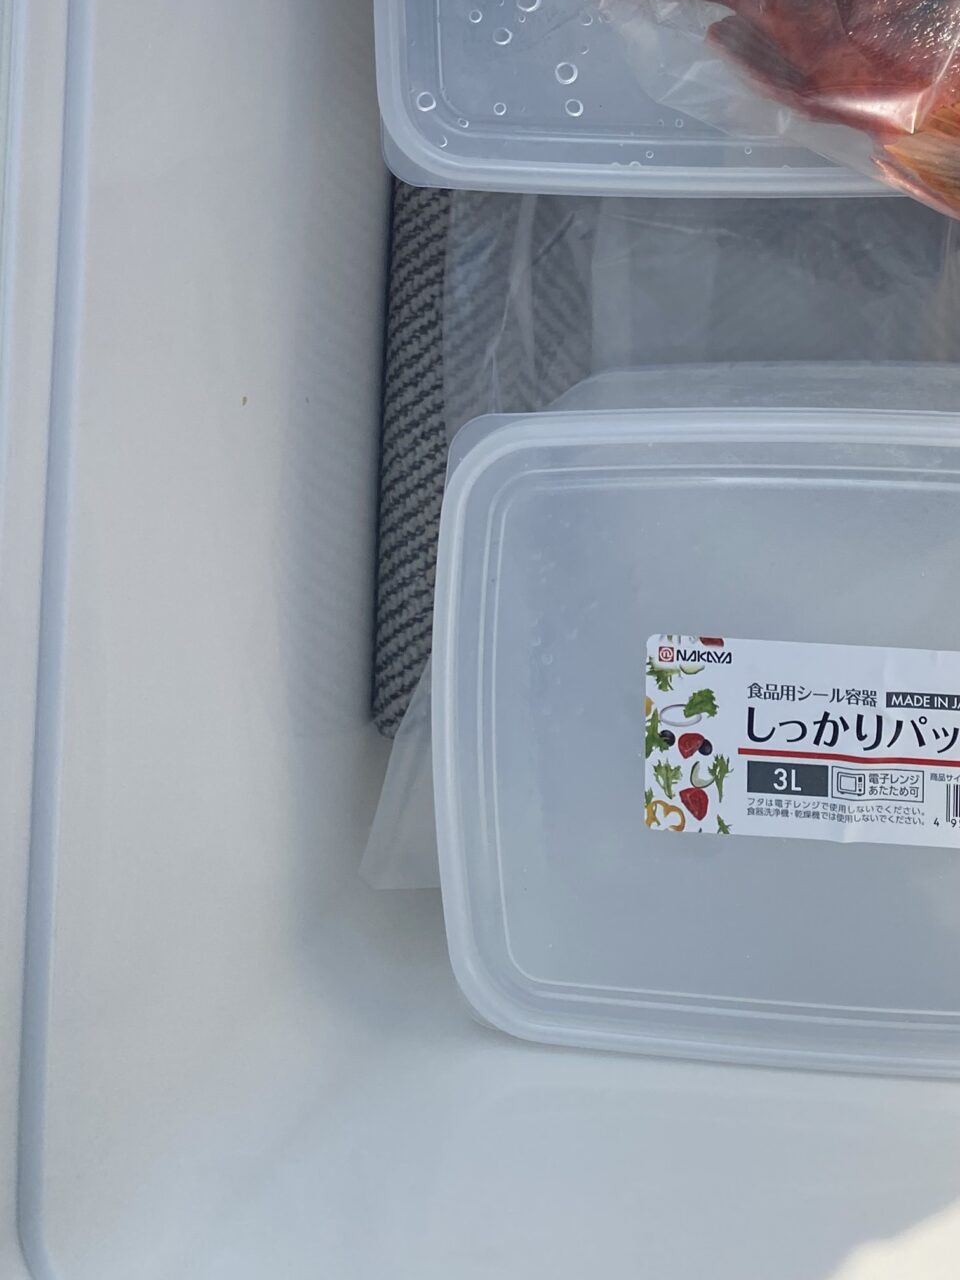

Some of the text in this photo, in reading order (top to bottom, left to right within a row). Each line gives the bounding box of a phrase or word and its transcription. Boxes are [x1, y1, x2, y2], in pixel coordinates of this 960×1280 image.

[676, 649, 732, 664] NAKAYA
[747, 682, 877, 707] 食品用シール容器
[891, 694, 931, 708] MADE
[934, 697, 948, 709] IN
[773, 768, 802, 792] 3L
[868, 773, 920, 785] 電子レンジ
[868, 786, 920, 798] あたため可
[933, 817, 940, 827] 4
